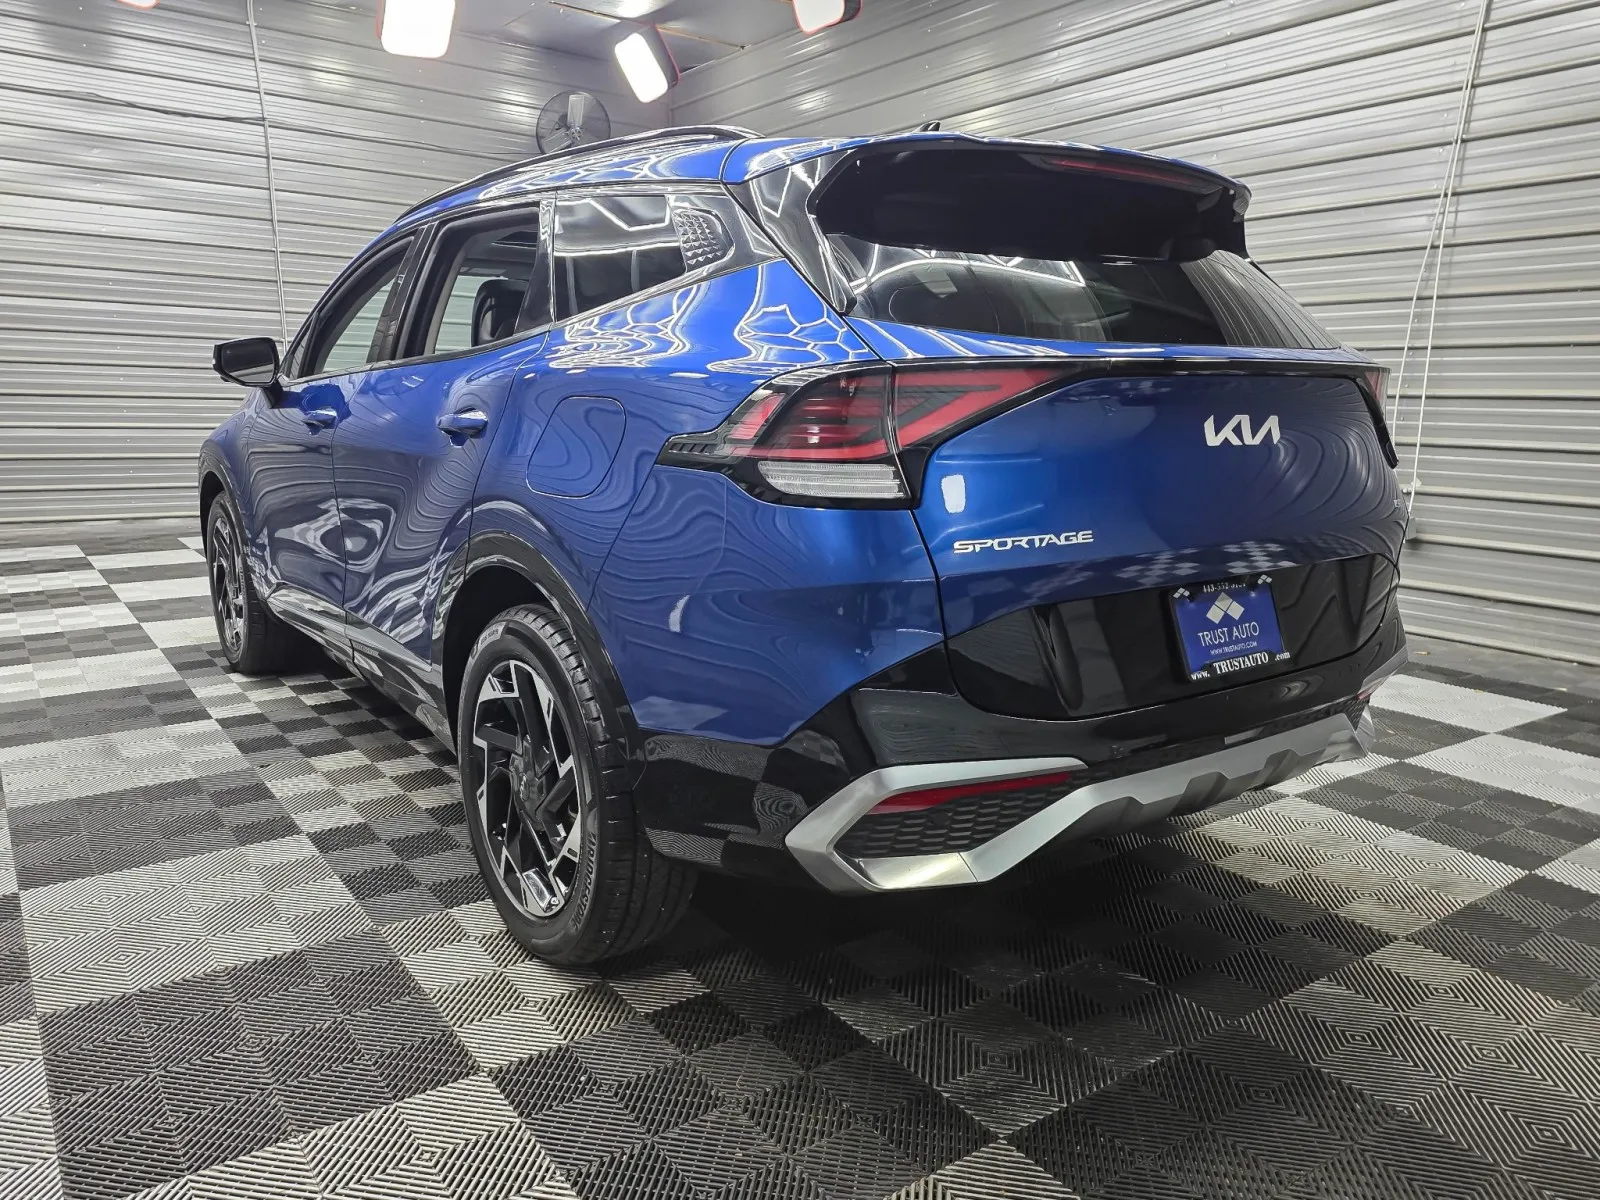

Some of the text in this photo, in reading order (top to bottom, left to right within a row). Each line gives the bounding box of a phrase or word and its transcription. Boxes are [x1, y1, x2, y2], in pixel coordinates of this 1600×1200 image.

[1204, 414, 1280, 447] KIA
[953, 530, 1094, 554] SPORTAGE
[1198, 621, 1260, 647] TRUST AUTO
[1213, 651, 1269, 675] TRUSTAUTO
[1274, 651, 1291, 661] .com
